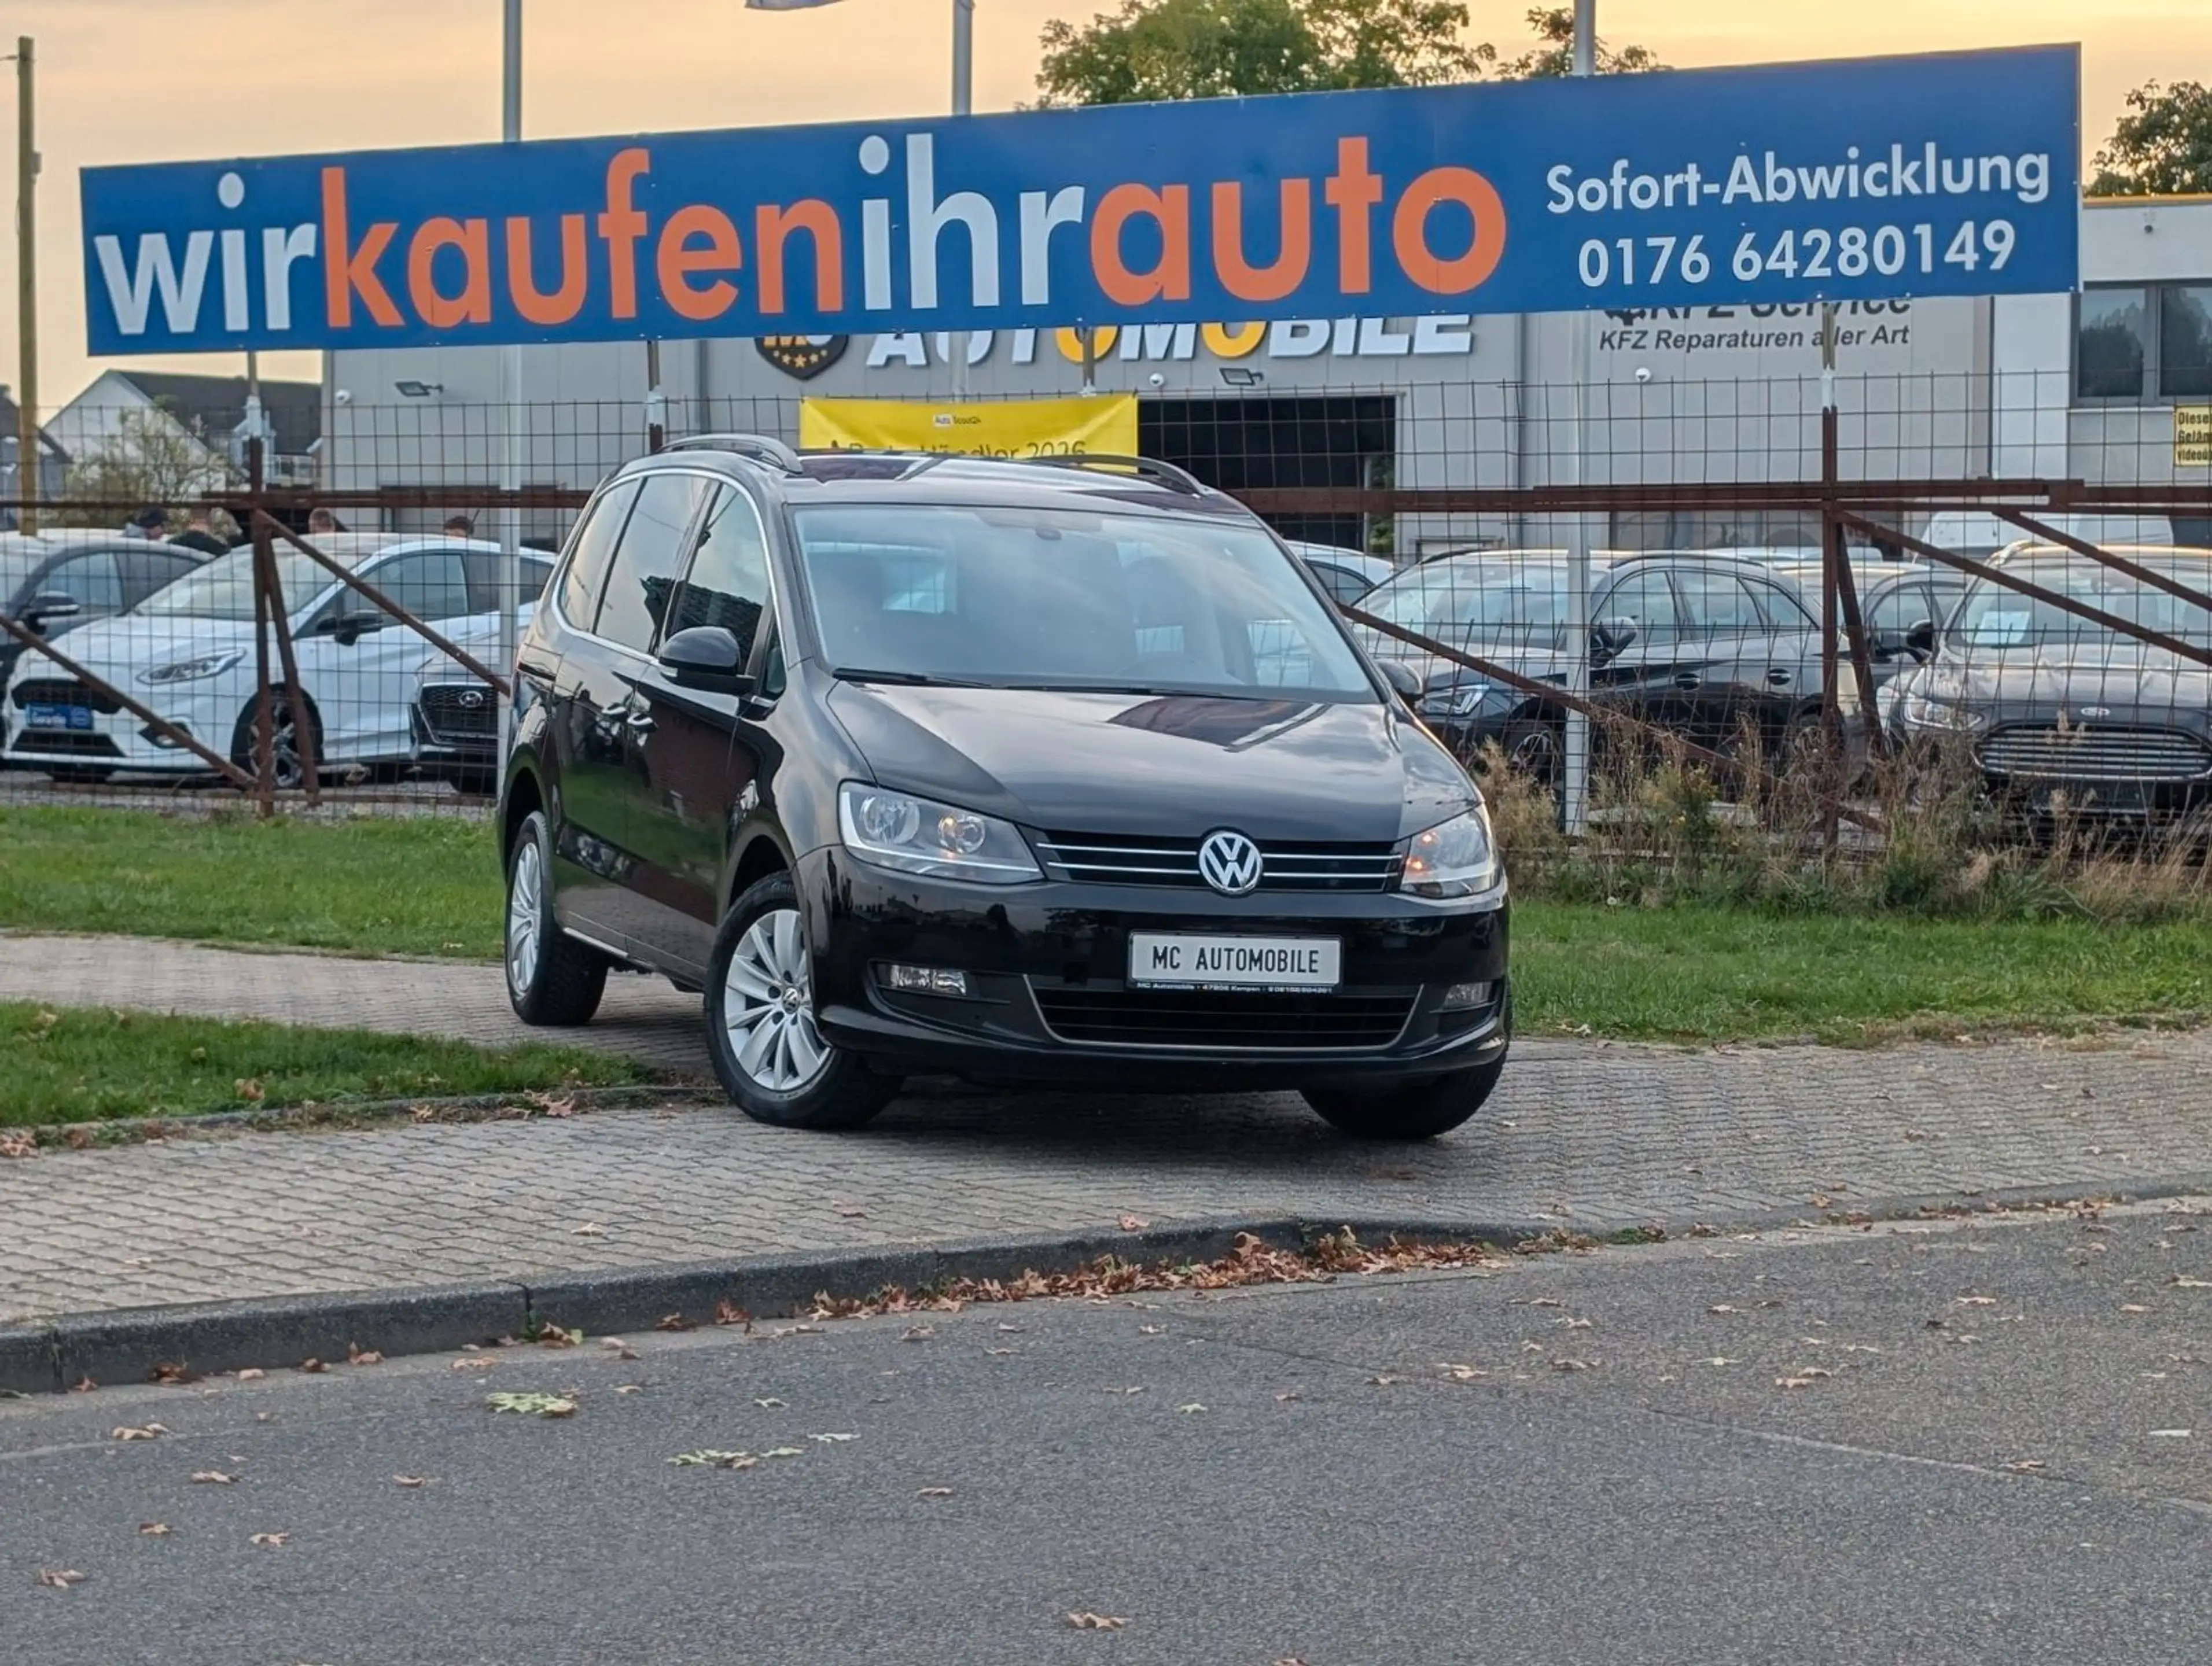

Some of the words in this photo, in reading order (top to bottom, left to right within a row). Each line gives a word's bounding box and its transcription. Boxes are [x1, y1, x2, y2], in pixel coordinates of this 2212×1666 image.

[1546, 142, 2049, 214] Sofort-Abwicklung
[1578, 235, 1710, 287] 0176
[1732, 219, 2015, 282] 64280149
[1599, 330, 1648, 350] KFZ
[1655, 329, 1804, 353] Reparaturen
[1811, 326, 1866, 346] aler
[1871, 324, 1910, 345] Art
[2177, 448, 2212, 461] videoü
[1152, 945, 1181, 970] MC
[1195, 947, 1319, 974] AUTOMOBILE
